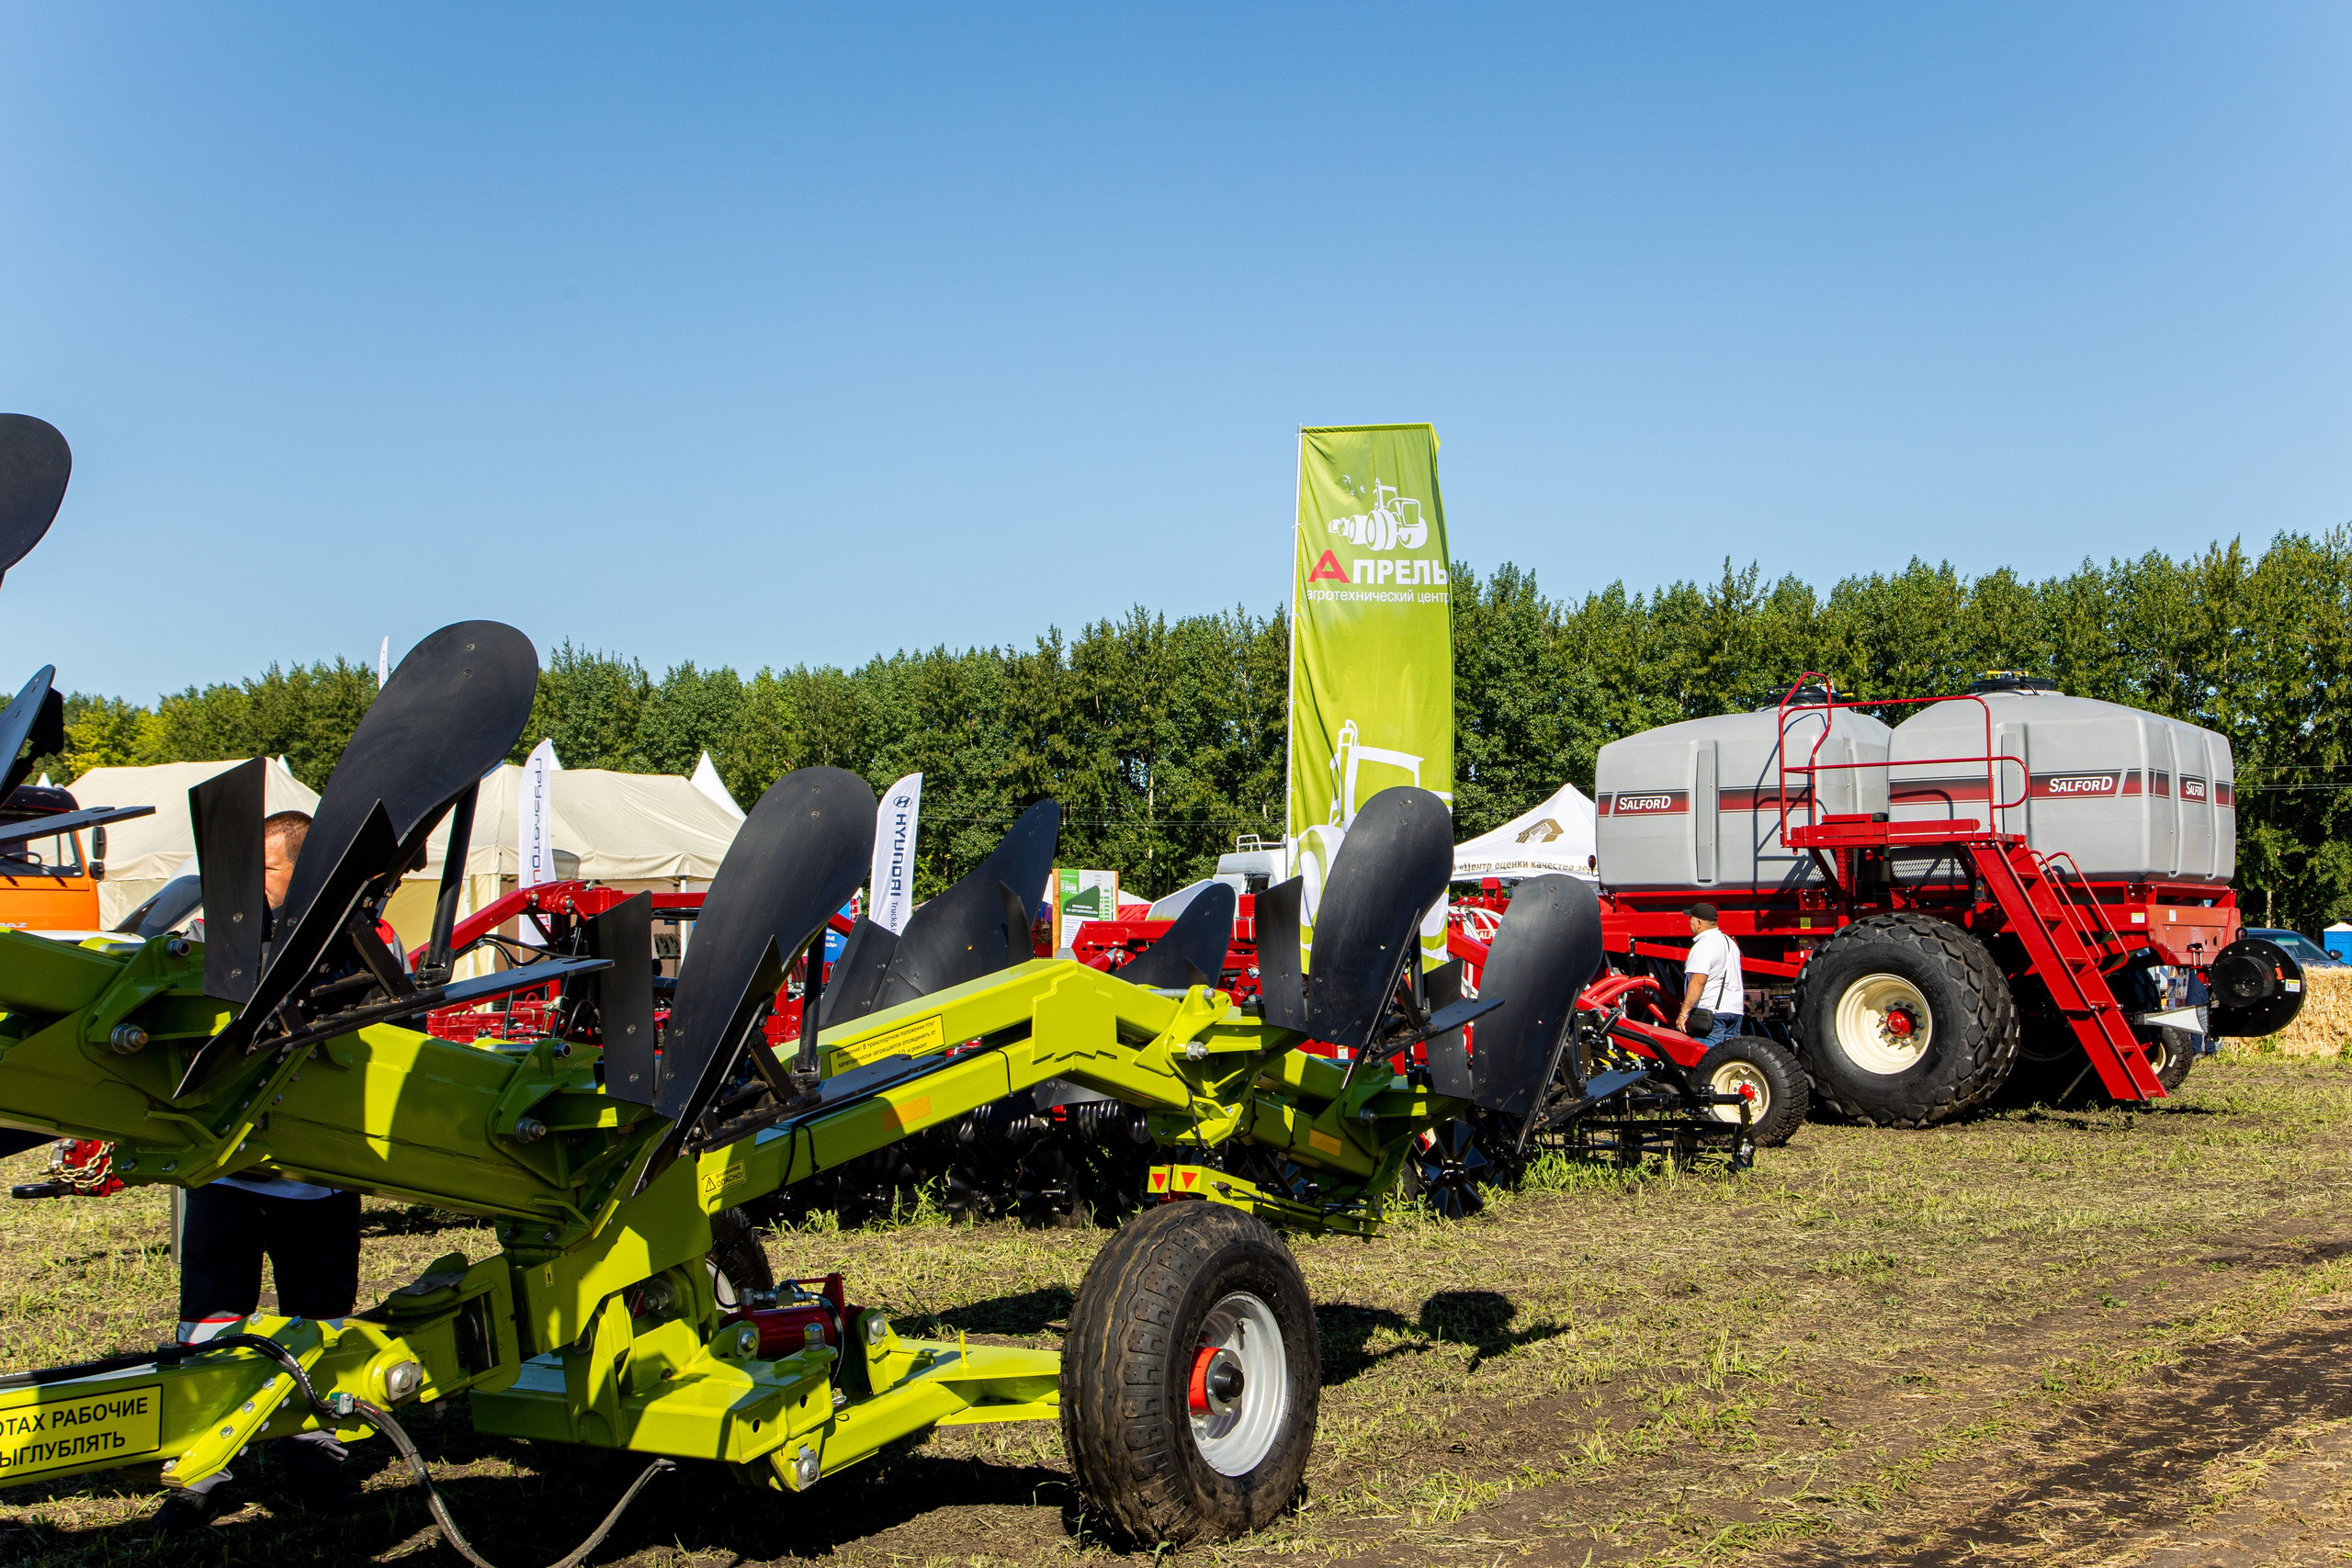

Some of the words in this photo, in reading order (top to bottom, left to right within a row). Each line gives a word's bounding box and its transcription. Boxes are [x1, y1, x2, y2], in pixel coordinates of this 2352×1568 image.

[1306, 589, 1415, 604] агротехнический
[1417, 592, 1450, 606] центр
[2048, 776, 2113, 793] SALFORD
[1619, 795, 1671, 810] SALFORD
[890, 814, 907, 897] HYUNDAI
[1495, 860, 1529, 871] оценки
[1531, 861, 1575, 872] качества
[836, 1044, 862, 1059] Внимание!
[867, 1033, 899, 1049] транспортном
[900, 1024, 925, 1038] положении
[873, 1043, 901, 1056] запрещается
[716, 1165, 741, 1179] ВНИМАНИЕ
[717, 1171, 743, 1187] ОПАСНО!
[0, 1413, 46, 1437] ТАХ
[52, 1396, 148, 1429] РАБОЧИЕ
